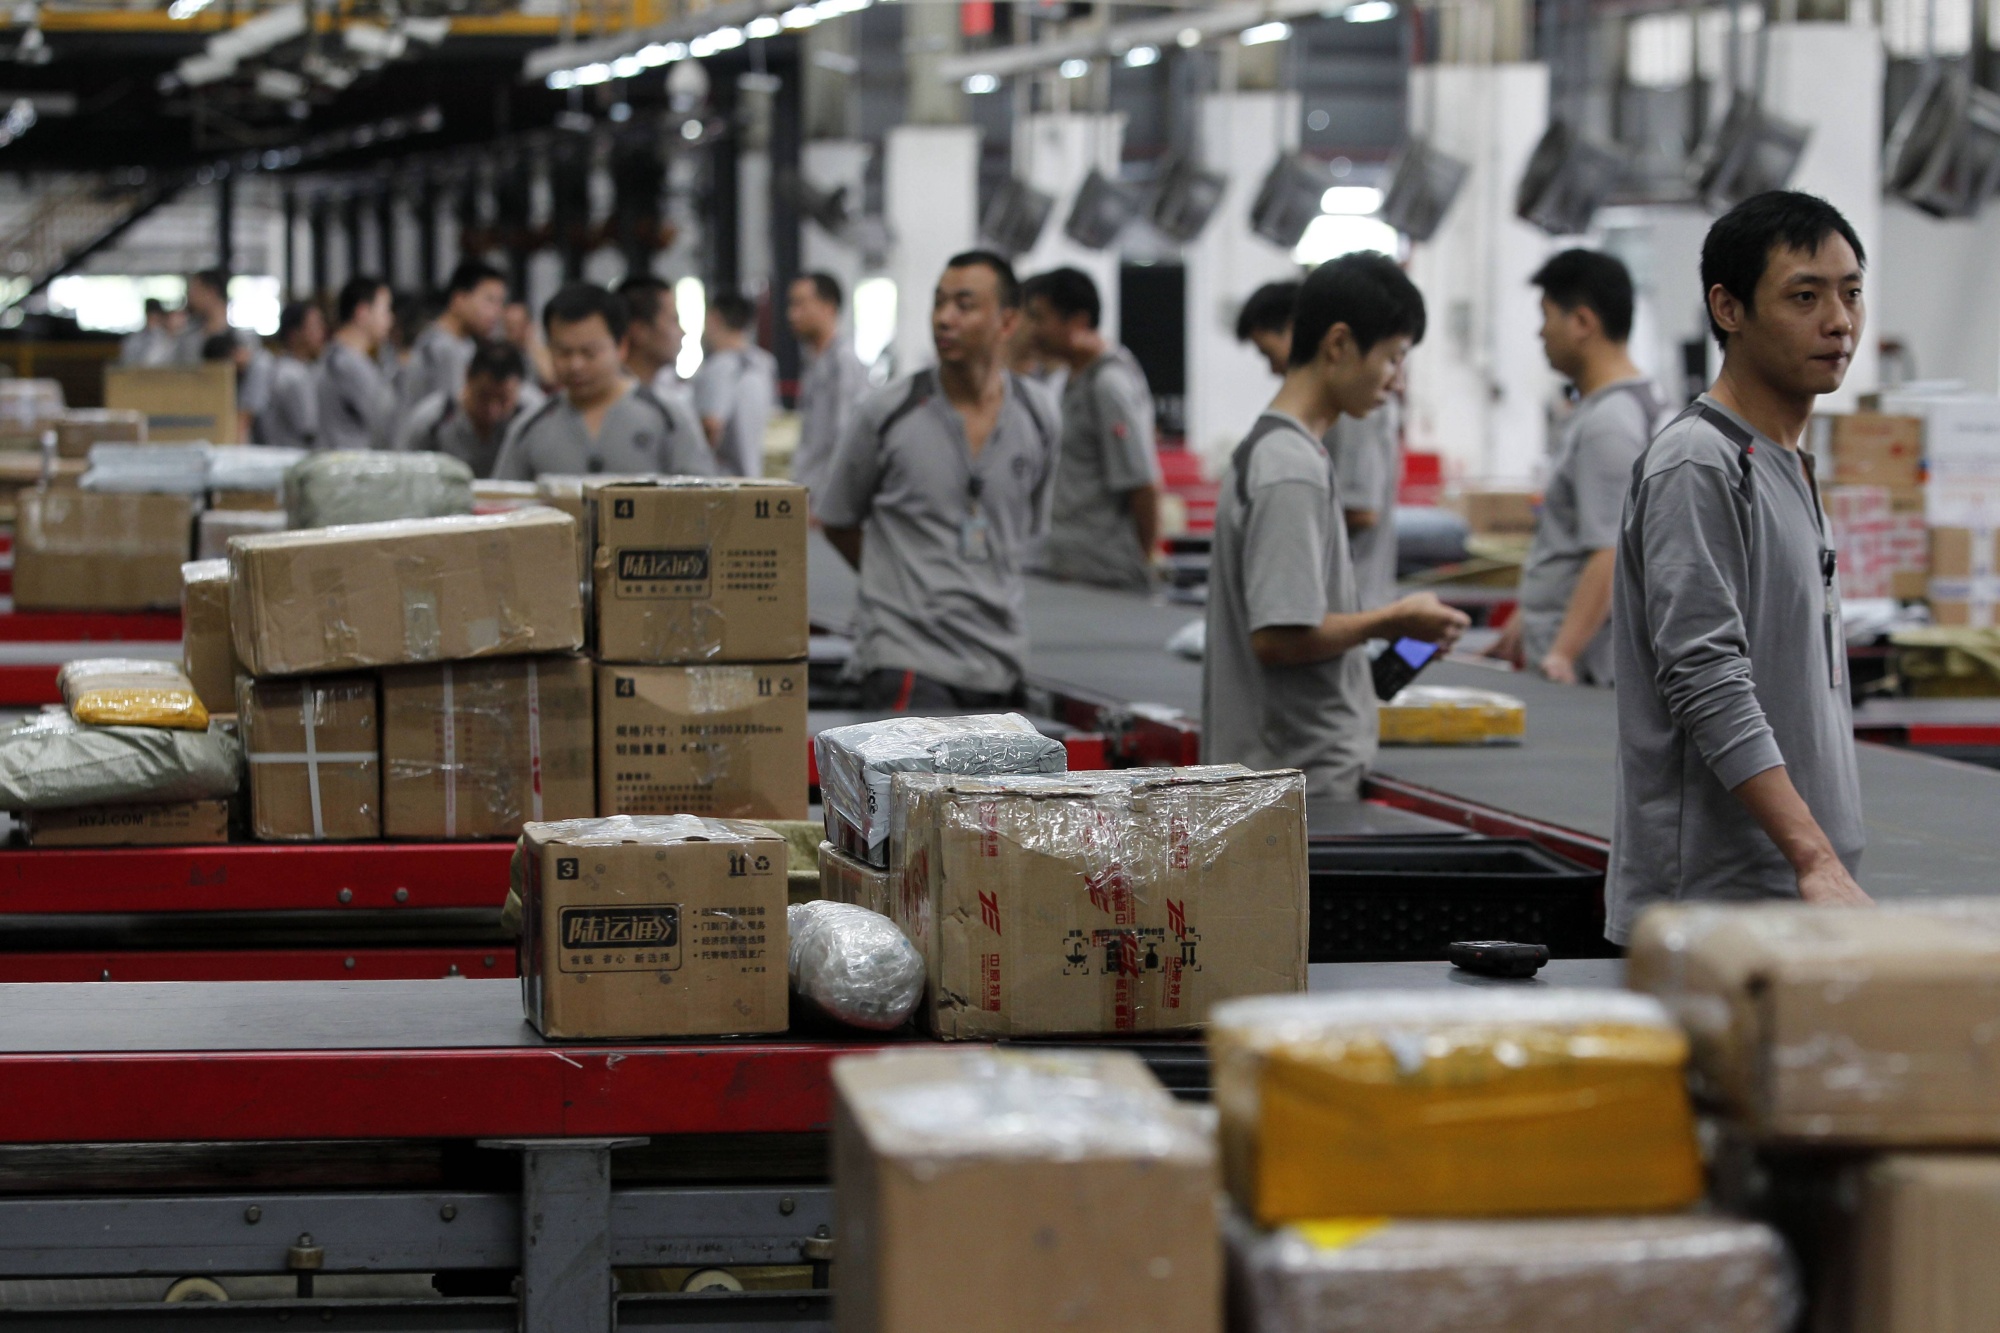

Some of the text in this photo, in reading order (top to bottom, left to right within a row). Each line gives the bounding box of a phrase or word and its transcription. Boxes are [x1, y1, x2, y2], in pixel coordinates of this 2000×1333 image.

[568, 916, 661, 943] 陆运通
[602, 954, 626, 964] 省心
[634, 952, 671, 963] 新选择
